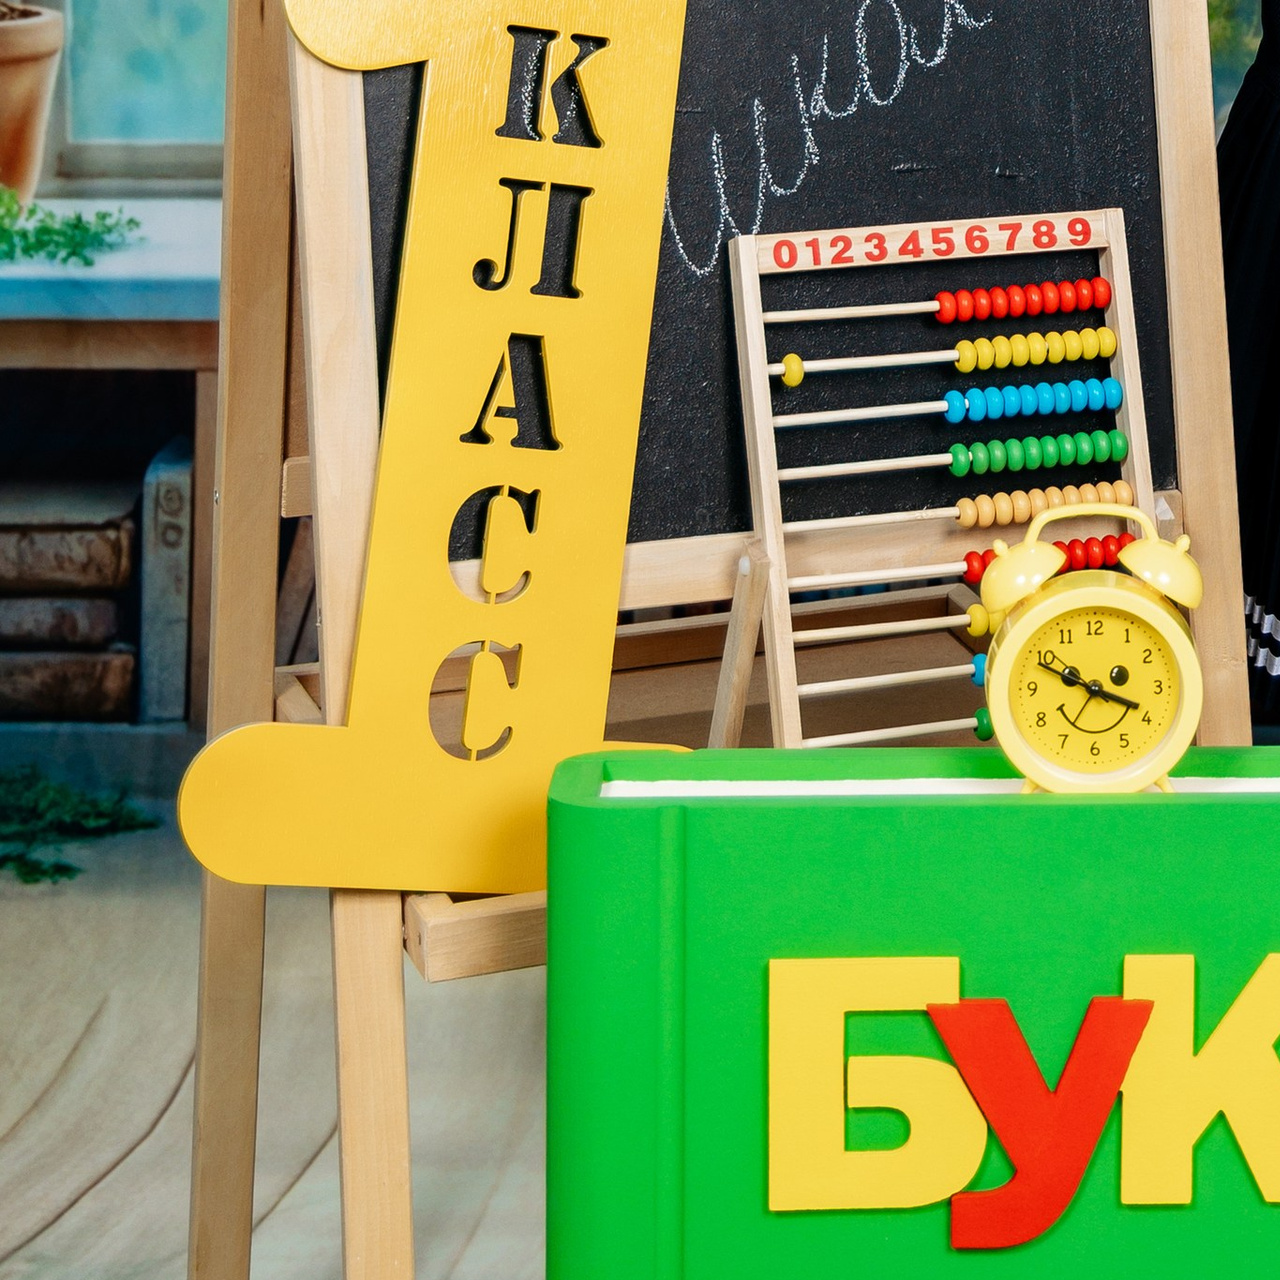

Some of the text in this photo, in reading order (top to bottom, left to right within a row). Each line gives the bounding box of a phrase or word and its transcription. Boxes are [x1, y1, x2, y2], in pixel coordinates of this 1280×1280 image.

[428, 24, 610, 762] КЛАСС
[1086, 621, 1104, 636] 12
[1124, 628, 1131, 643] 1
[1059, 629, 1073, 644] 11
[1037, 650, 1055, 665] 10
[1143, 649, 1153, 664] 2
[1027, 681, 1038, 697] 9
[1154, 680, 1163, 695] 3
[1036, 712, 1046, 727] 8
[1141, 710, 1152, 726] 4
[1057, 734, 1069, 749] 7
[1090, 741, 1100, 756] 6
[1119, 733, 1130, 749] 5
